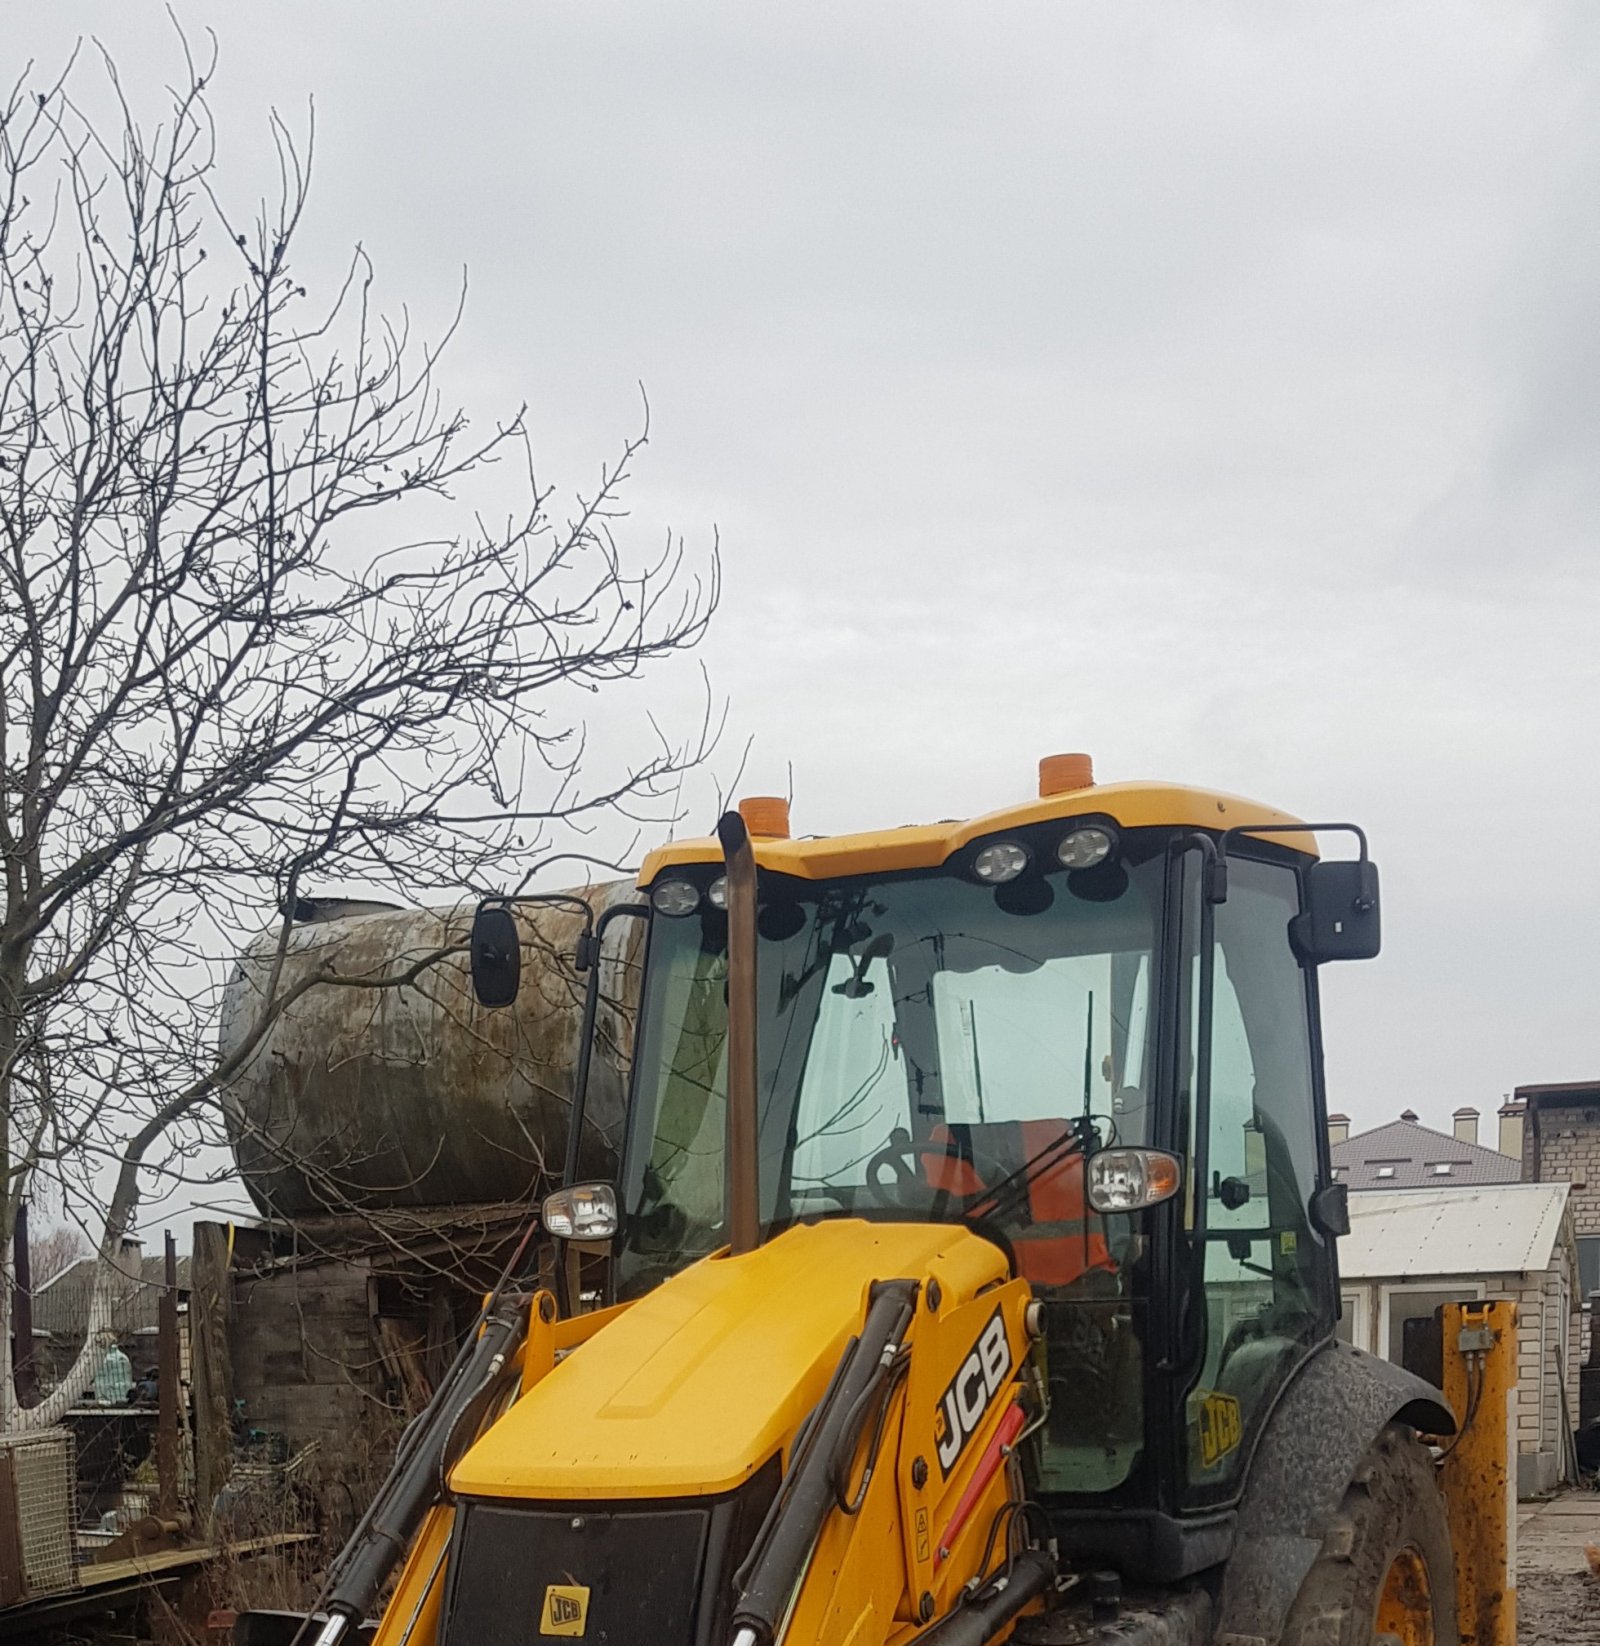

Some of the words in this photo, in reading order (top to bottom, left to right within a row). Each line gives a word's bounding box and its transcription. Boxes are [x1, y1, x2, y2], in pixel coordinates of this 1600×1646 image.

[938, 1315, 1010, 1469] JCB
[1203, 1399, 1238, 1459] JCB
[553, 1598, 578, 1622] JCB
